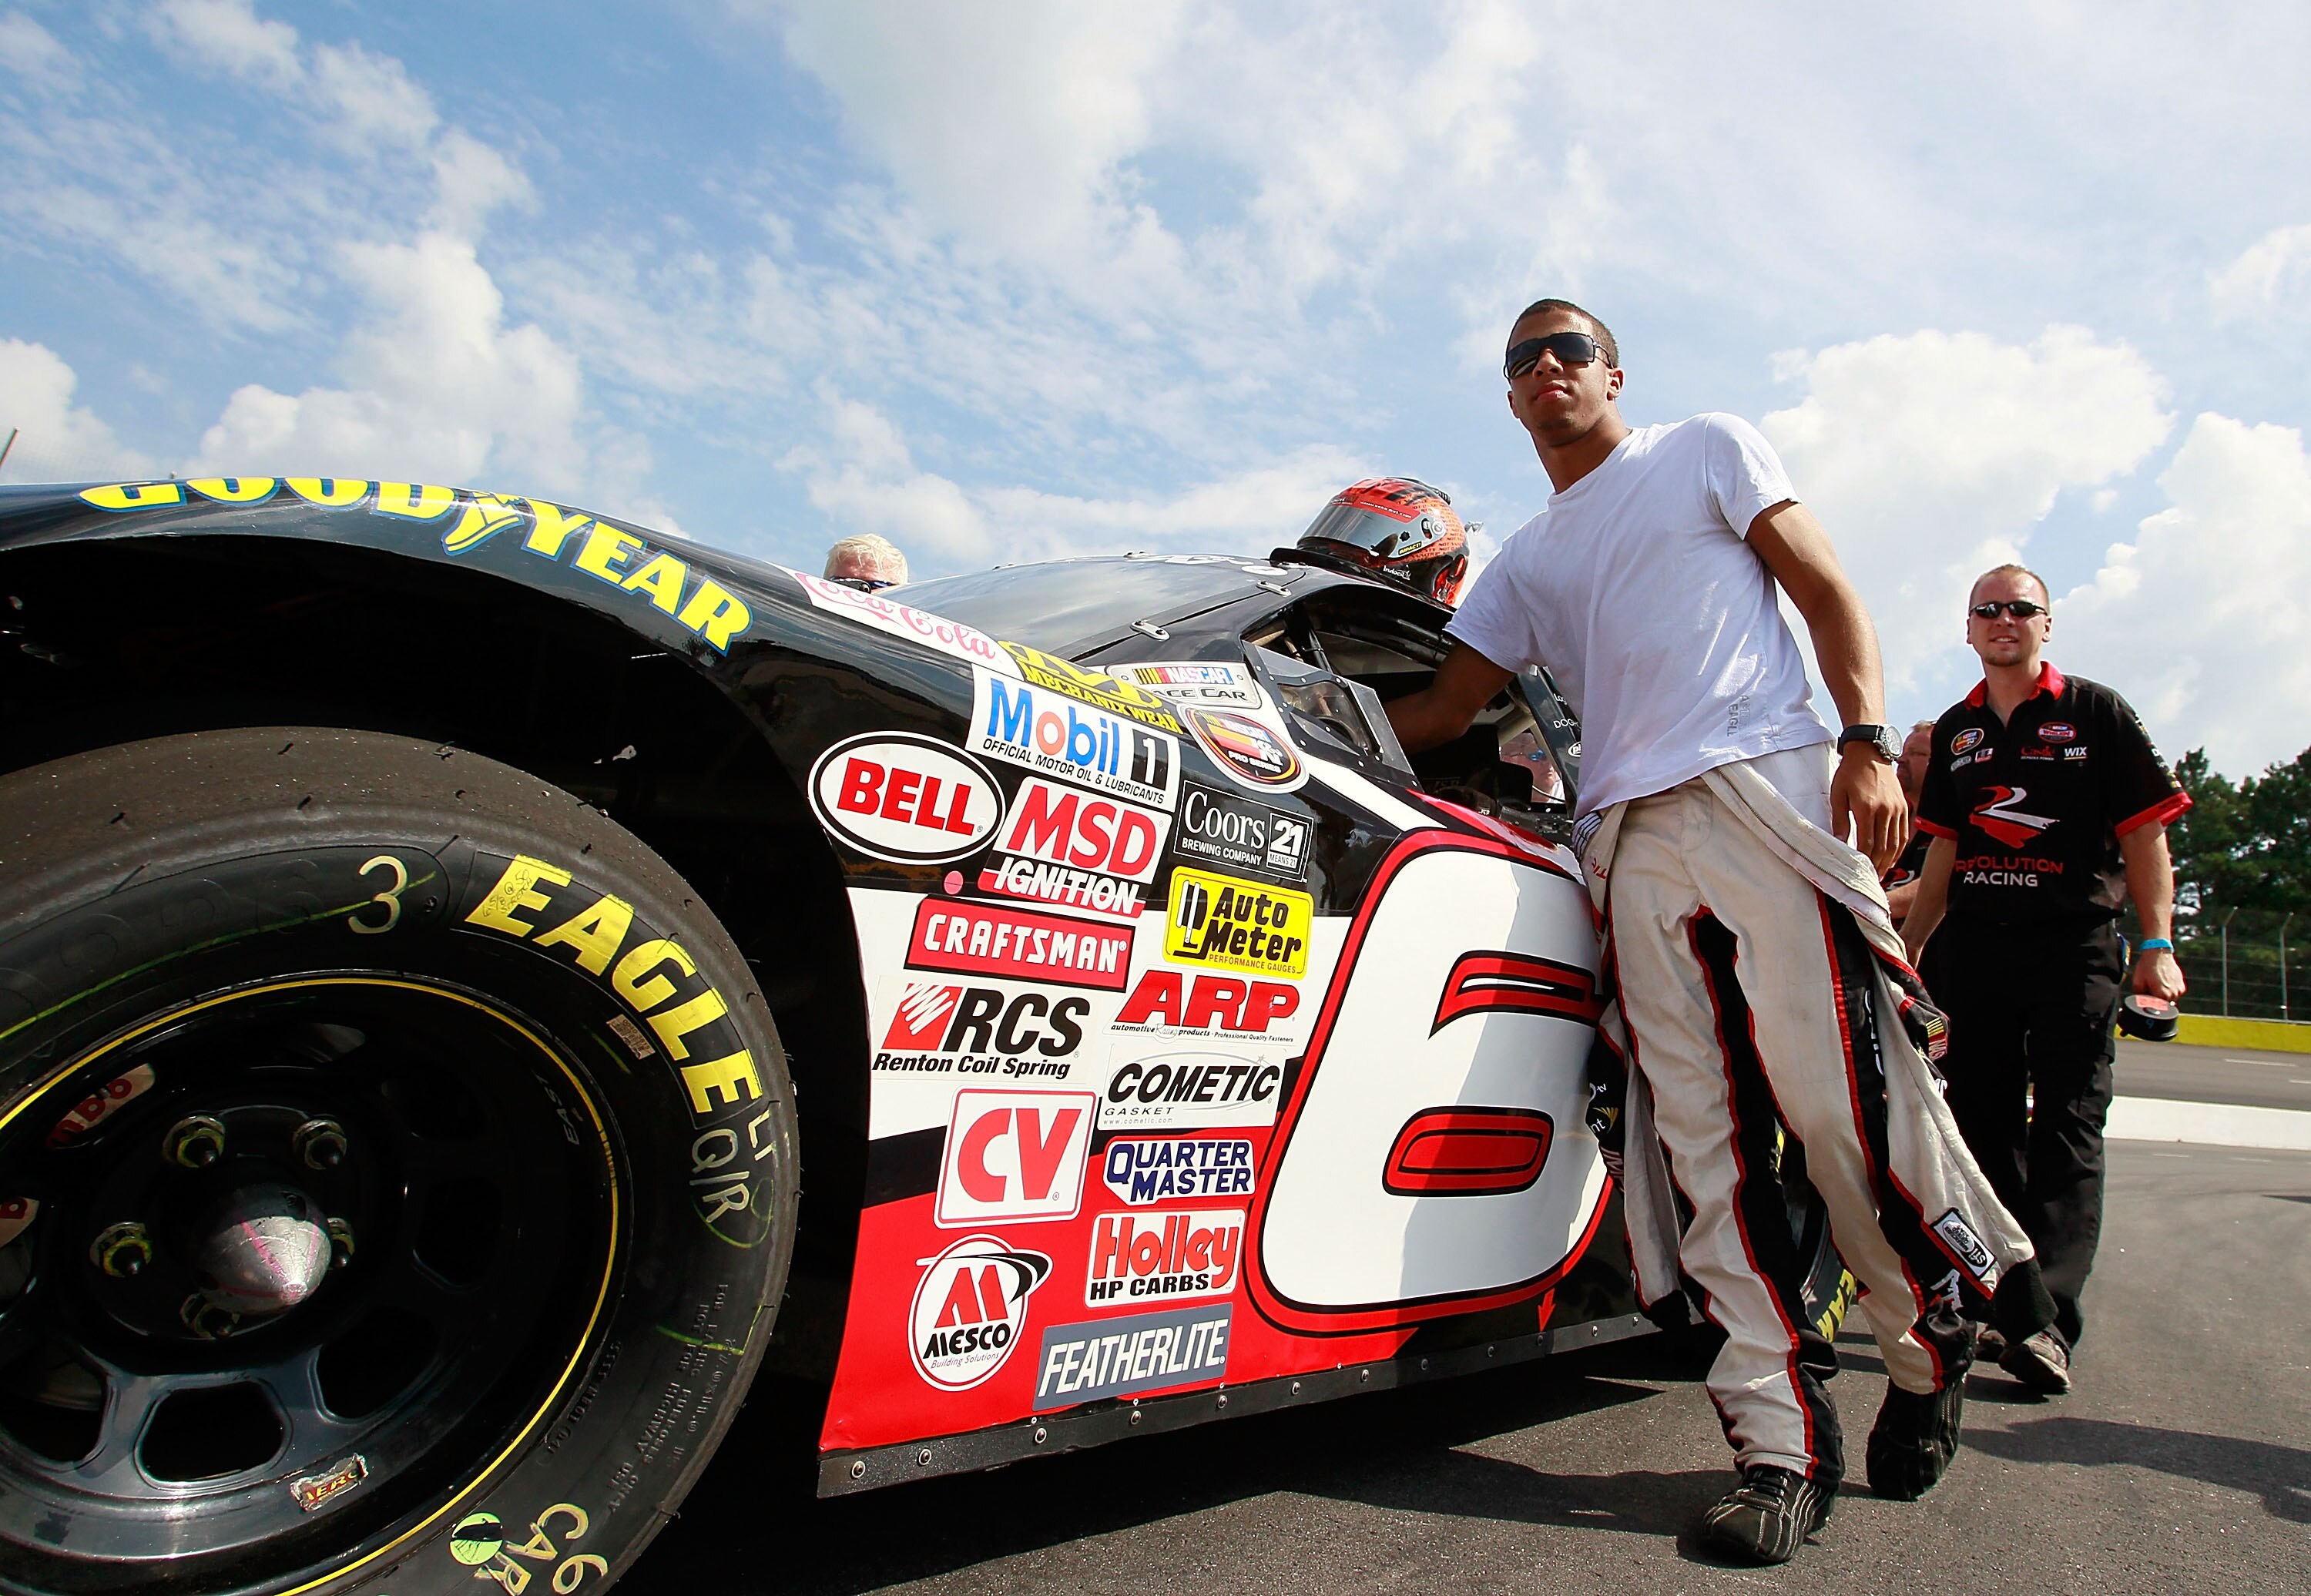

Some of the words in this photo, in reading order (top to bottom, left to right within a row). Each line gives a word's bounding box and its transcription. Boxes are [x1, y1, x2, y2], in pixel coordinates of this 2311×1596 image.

[80, 477, 752, 654] GOODYEAR
[1169, 667, 1233, 685] NASCAR
[1200, 688, 1248, 701] CAR
[1023, 666, 1130, 715] MECHANIX
[1129, 704, 1184, 735] WEAR
[988, 678, 1119, 776] Mobil
[1142, 737, 1156, 785] 1
[2064, 746, 2088, 757] WIX
[983, 738, 1031, 763] OFFICIAL
[1035, 755, 1073, 776] MOTOR
[1078, 768, 1092, 783] OIL
[1095, 773, 1102, 784] &
[1105, 774, 1165, 804] LUBRICANTS
[1228, 751, 1249, 763] PRO
[1249, 756, 1282, 773] SERIES
[837, 757, 974, 836] BELL
[1006, 785, 1158, 878] MSD
[1184, 791, 1266, 850] Coors
[1270, 820, 1304, 857] 21
[1182, 837, 1221, 857] BREWING
[1223, 847, 1262, 866] COMPANY
[1269, 852, 1289, 866] MEANS
[1290, 858, 1296, 867] 21
[347, 854, 408, 935] 3
[994, 856, 1142, 913] IGNITION
[1964, 871, 2038, 887] RACING
[1213, 887, 1289, 928] Auto
[924, 913, 1120, 974] CRAFTSMAN
[1209, 919, 1302, 963] Meter
[465, 853, 763, 1114] EAGLE
[1209, 954, 1265, 969] PERFORMANCE
[1266, 961, 1296, 974] GAUGES
[1115, 970, 1300, 1033] ARP
[941, 989, 1090, 1058] RCS
[1111, 1024, 1156, 1033] automotive
[1179, 1028, 1210, 1037] products
[1214, 1031, 1248, 1040] Professional
[1249, 1034, 1267, 1042] Quality
[873, 1053, 953, 1074] Renton
[958, 1054, 999, 1075] Coil
[1002, 1058, 1071, 1080] Spring
[1108, 1063, 1280, 1103] COMETIC
[1260, 851, 1608, 1308] 6
[1103, 1117, 1173, 1125] www.cometic.com
[1105, 1107, 1174, 1116] GASKET
[958, 1108, 1082, 1202] CV
[1106, 1141, 1250, 1184] QUARTER
[1129, 1167, 1252, 1202] MASTER
[1092, 1215, 1239, 1289] Holley
[1090, 1281, 1122, 1300] HP
[1129, 1273, 1209, 1296] CARBS
[922, 1323, 1011, 1360] MESCO
[930, 1354, 962, 1370] Building
[964, 1351, 1000, 1366] Solutions
[1038, 1318, 1228, 1397] FEATHERLITE
